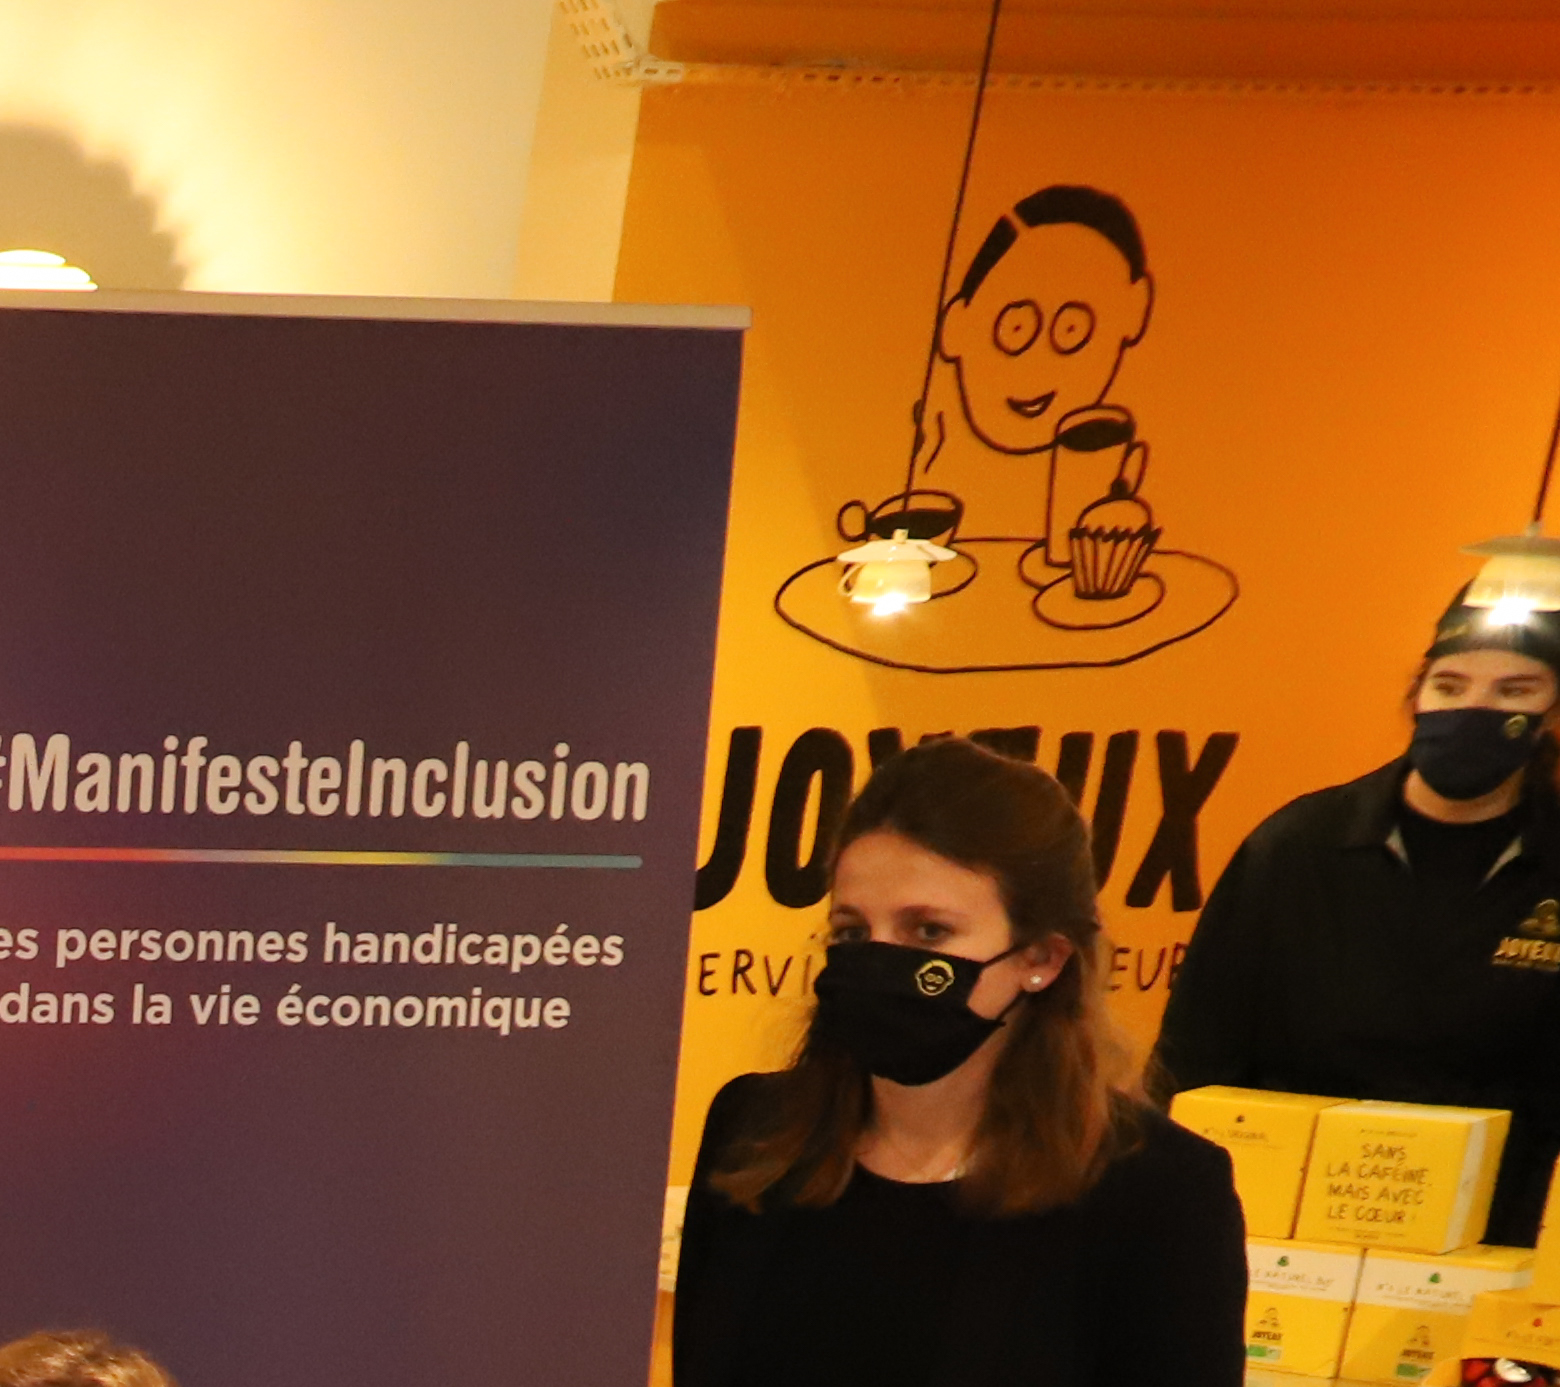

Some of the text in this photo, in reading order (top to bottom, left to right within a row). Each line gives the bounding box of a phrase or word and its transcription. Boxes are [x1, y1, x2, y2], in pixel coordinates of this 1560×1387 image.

[692, 725, 1241, 912] JOUX
[56, 926, 309, 971] personnes
[324, 920, 624, 975] handicapées
[699, 949, 813, 997] ERVI
[131, 984, 174, 1025] la
[190, 985, 261, 1026] vie
[276, 983, 571, 1037] économique
[1361, 1143, 1408, 1160] SANS
[1327, 1163, 1351, 1178] LA
[1327, 1183, 1425, 1205] MAIS AVEC
[1327, 1204, 1347, 1221] LE
